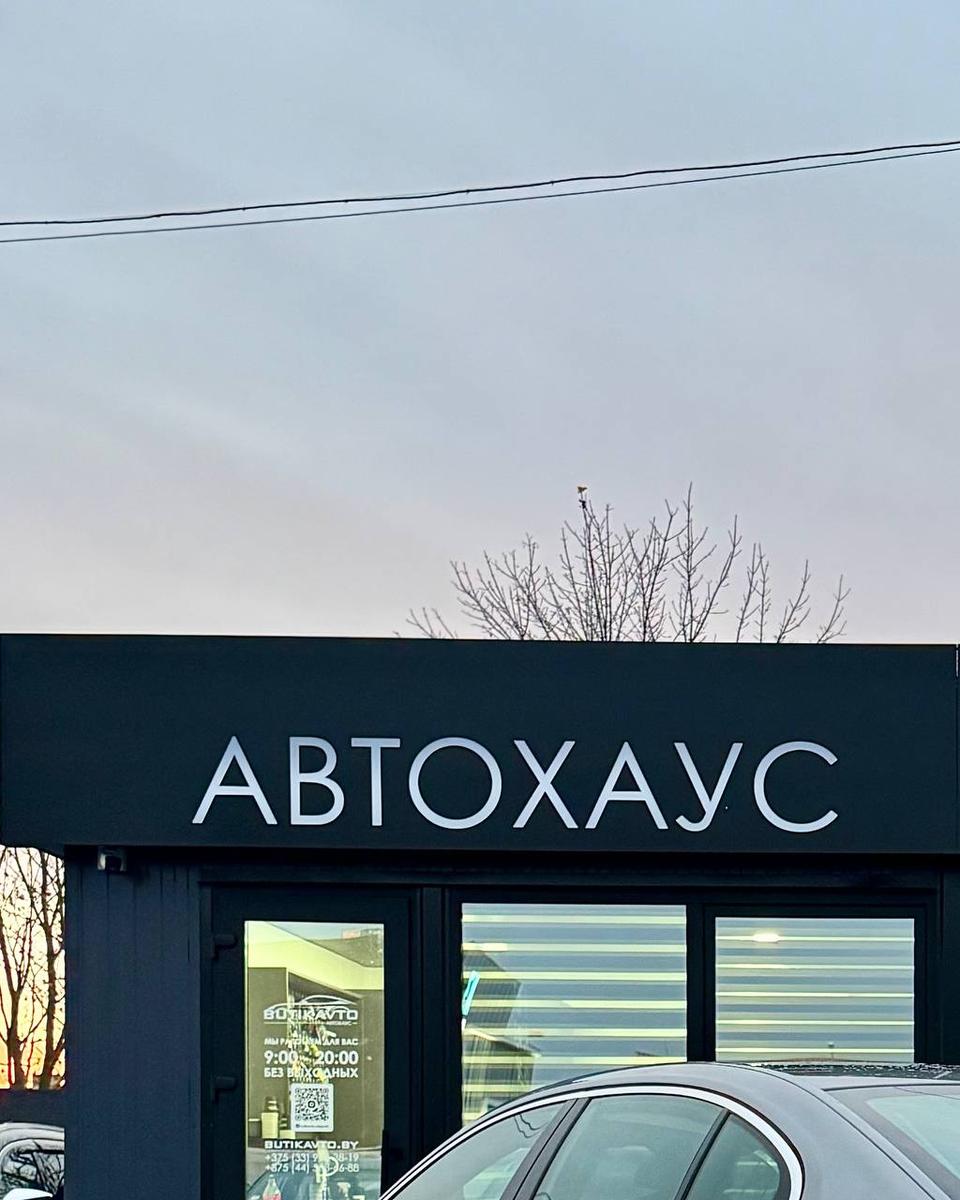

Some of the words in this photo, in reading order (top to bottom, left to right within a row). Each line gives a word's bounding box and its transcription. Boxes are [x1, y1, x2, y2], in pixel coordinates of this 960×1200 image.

[192, 735, 839, 833] АВТОХАУС
[263, 1008, 358, 1020] BUTIKAVTO
[323, 1038, 340, 1046] ДЛЯ
[264, 1050, 299, 1065] 9:00
[315, 1050, 359, 1065] 20:00
[264, 1067, 284, 1078] БЕЗ
[264, 1140, 360, 1149] BUTIKAVTO.BY
[291, 1153, 310, 1163] (33)
[291, 1163, 310, 1174] (44)
